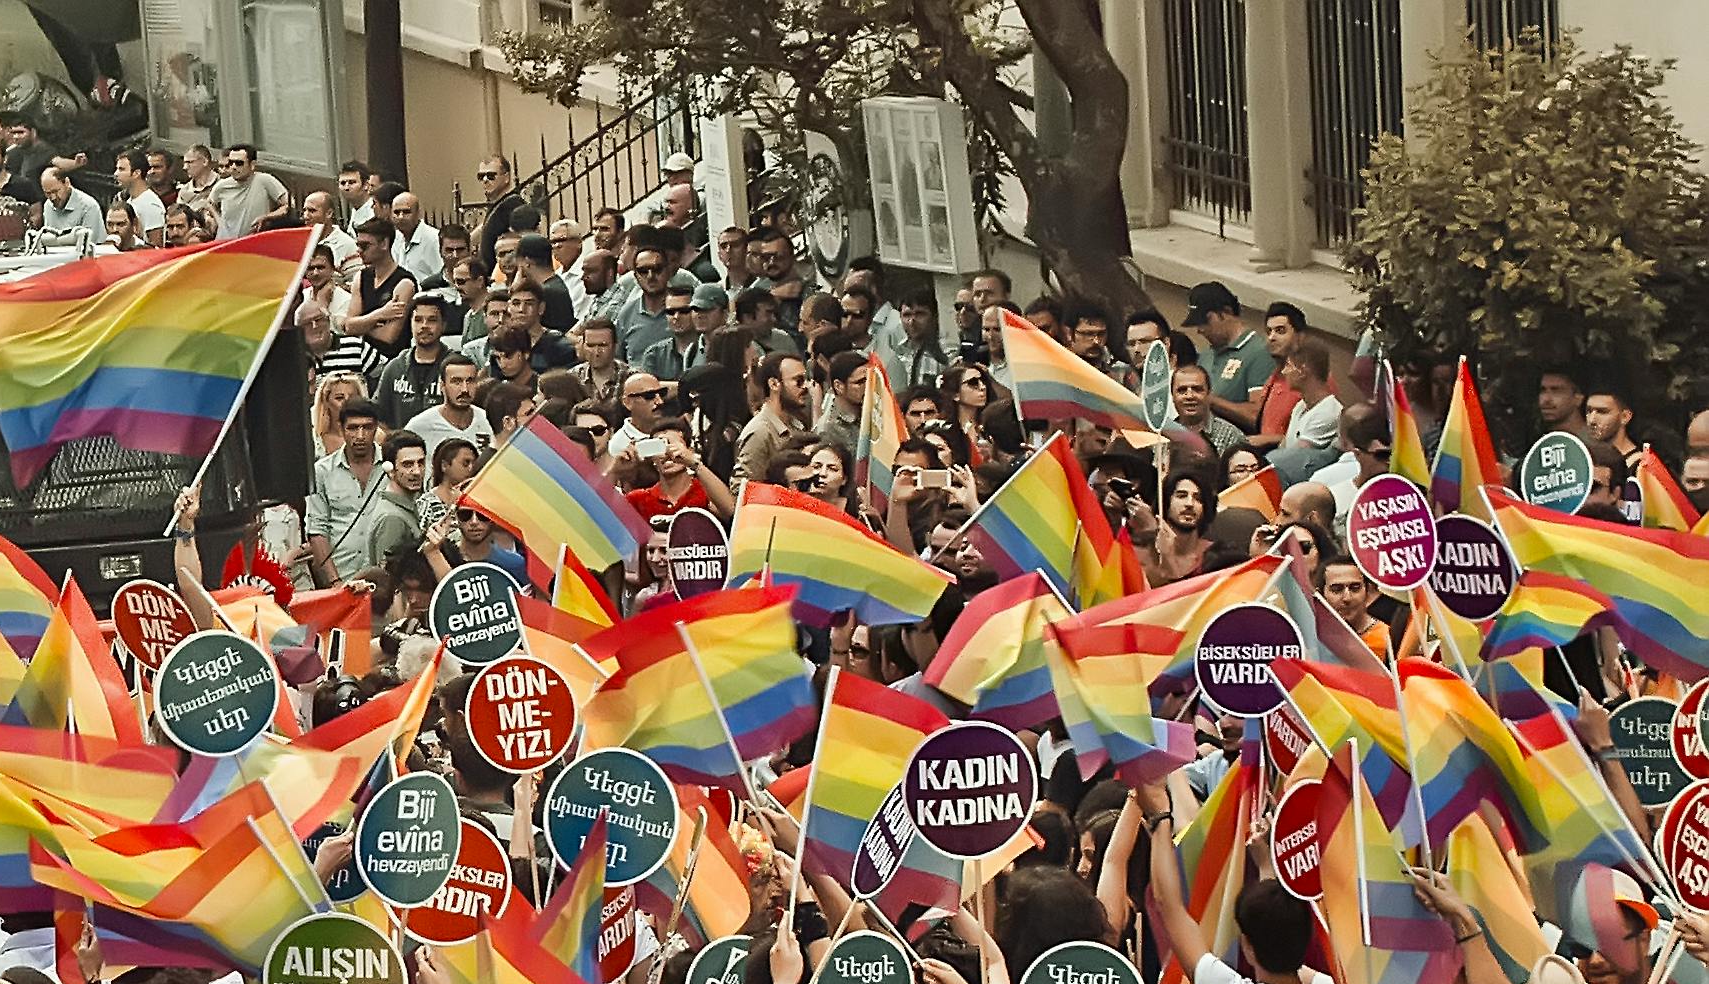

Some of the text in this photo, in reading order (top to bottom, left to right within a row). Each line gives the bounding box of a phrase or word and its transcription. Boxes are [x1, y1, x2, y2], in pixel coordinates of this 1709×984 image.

[1357, 491, 1421, 520] YAŞASIN
[1355, 518, 1430, 550] EŞCİNSEL
[1377, 545, 1425, 578] AŞK!
[1431, 574, 1507, 596] KADINA
[125, 589, 184, 620] DÖN-
[447, 601, 510, 632] evîna
[138, 616, 183, 643] ME-
[445, 616, 519, 650] hevzayend
[173, 646, 243, 685] Կեցցե
[1208, 662, 1272, 687] VARD
[485, 665, 558, 702] DÖN-
[203, 705, 251, 736] սեր
[498, 702, 553, 731] ME-
[1620, 717, 1670, 742] Կեցց
[495, 729, 553, 762] YİZ!
[1267, 711, 1309, 758] VARDI
[583, 766, 657, 807] Կեցցե
[918, 752, 1019, 791] KADIN
[1630, 766, 1672, 792] սեր
[915, 792, 1025, 827] KADINA
[377, 825, 444, 853] evîna
[450, 863, 506, 890] EKSLER
[433, 884, 492, 918] RDIR
[282, 945, 390, 984] ALIŞIN
[834, 953, 897, 984] Կեցցե
